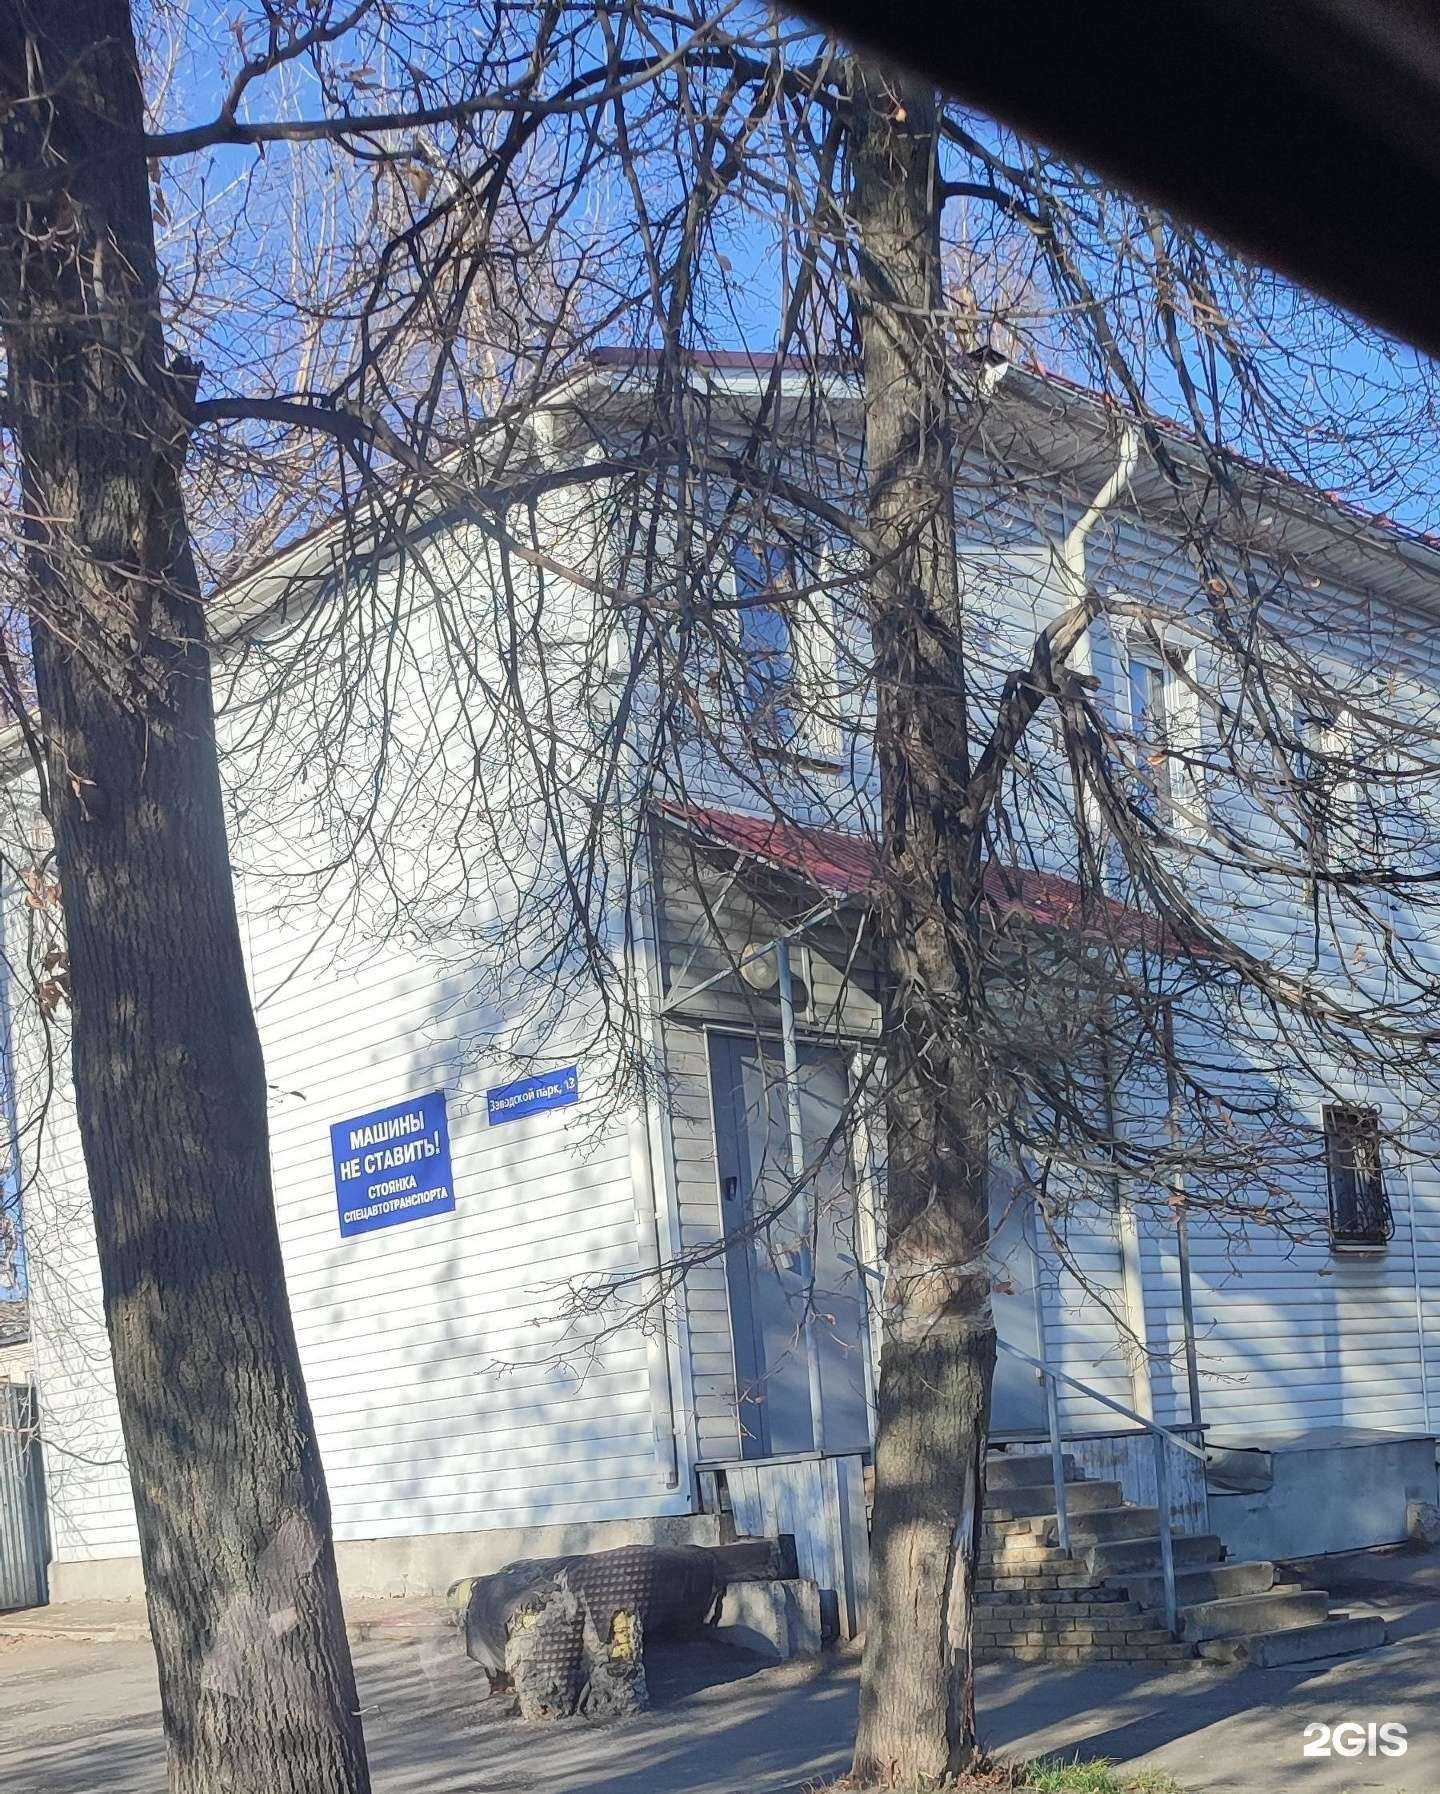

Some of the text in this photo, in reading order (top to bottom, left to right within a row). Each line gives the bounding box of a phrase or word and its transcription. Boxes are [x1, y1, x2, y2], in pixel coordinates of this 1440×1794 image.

[349, 1111, 425, 1150] МАШИНЫ
[340, 1130, 441, 1181] НЕ СТАВИТЬ!
[343, 1186, 448, 1223] СПЕЦАВТОТРАНСПОРТА
[368, 1174, 418, 1199] СТОЯНКА
